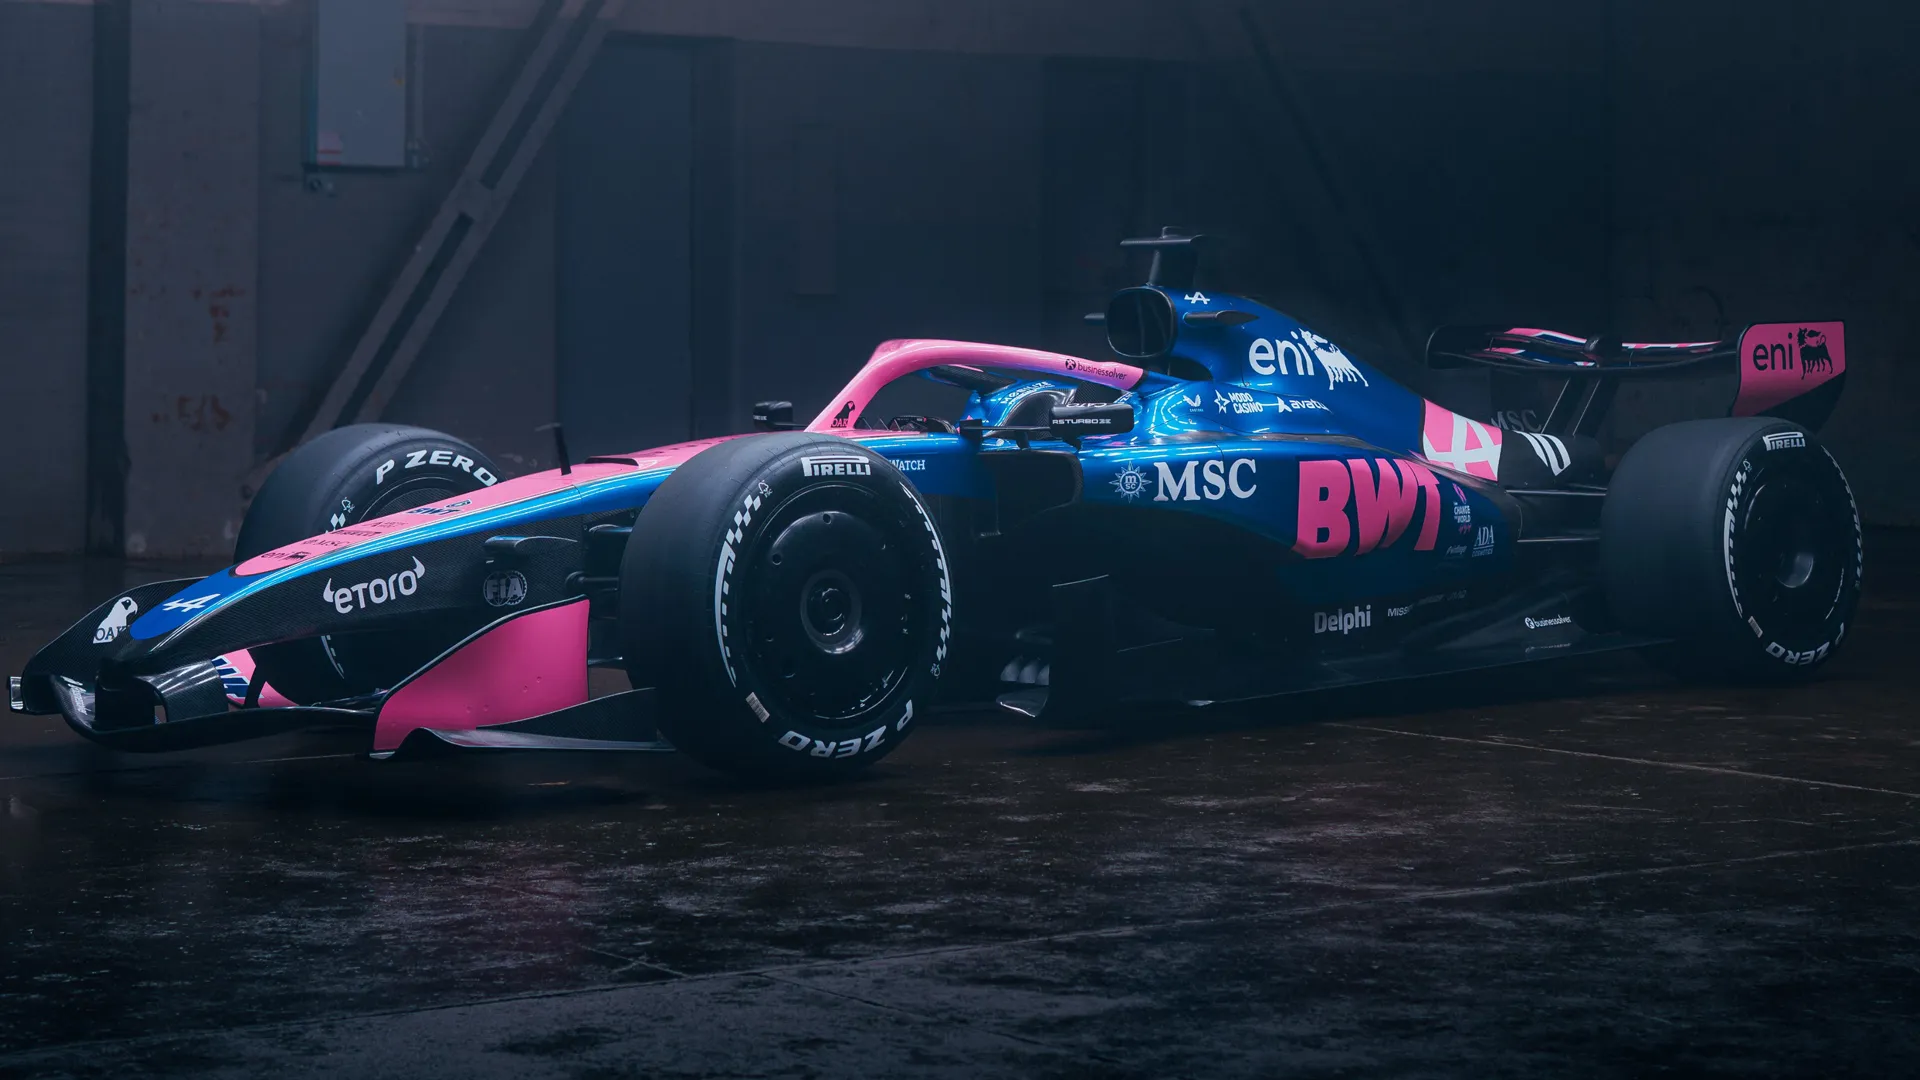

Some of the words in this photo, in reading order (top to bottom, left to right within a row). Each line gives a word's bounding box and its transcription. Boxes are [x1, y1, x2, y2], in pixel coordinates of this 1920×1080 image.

[1248, 331, 1314, 376] eni
[1753, 332, 1793, 371] eni
[1077, 361, 1127, 380] businessolver
[1228, 392, 1254, 402] MODO
[1233, 402, 1264, 414] CASINO
[1763, 431, 1806, 451] PIRELLI
[376, 459, 395, 485] P
[404, 449, 498, 487] ZERO
[801, 455, 871, 476] PIRELLI
[1153, 458, 1257, 501] MSC
[1291, 457, 1441, 560] BWT
[1473, 525, 1495, 547] ADA
[486, 577, 524, 600] FIA
[1314, 604, 1372, 635] Delphi
[1765, 641, 1830, 666] ZERO
[897, 699, 914, 731] P
[778, 725, 887, 759] ZERO
